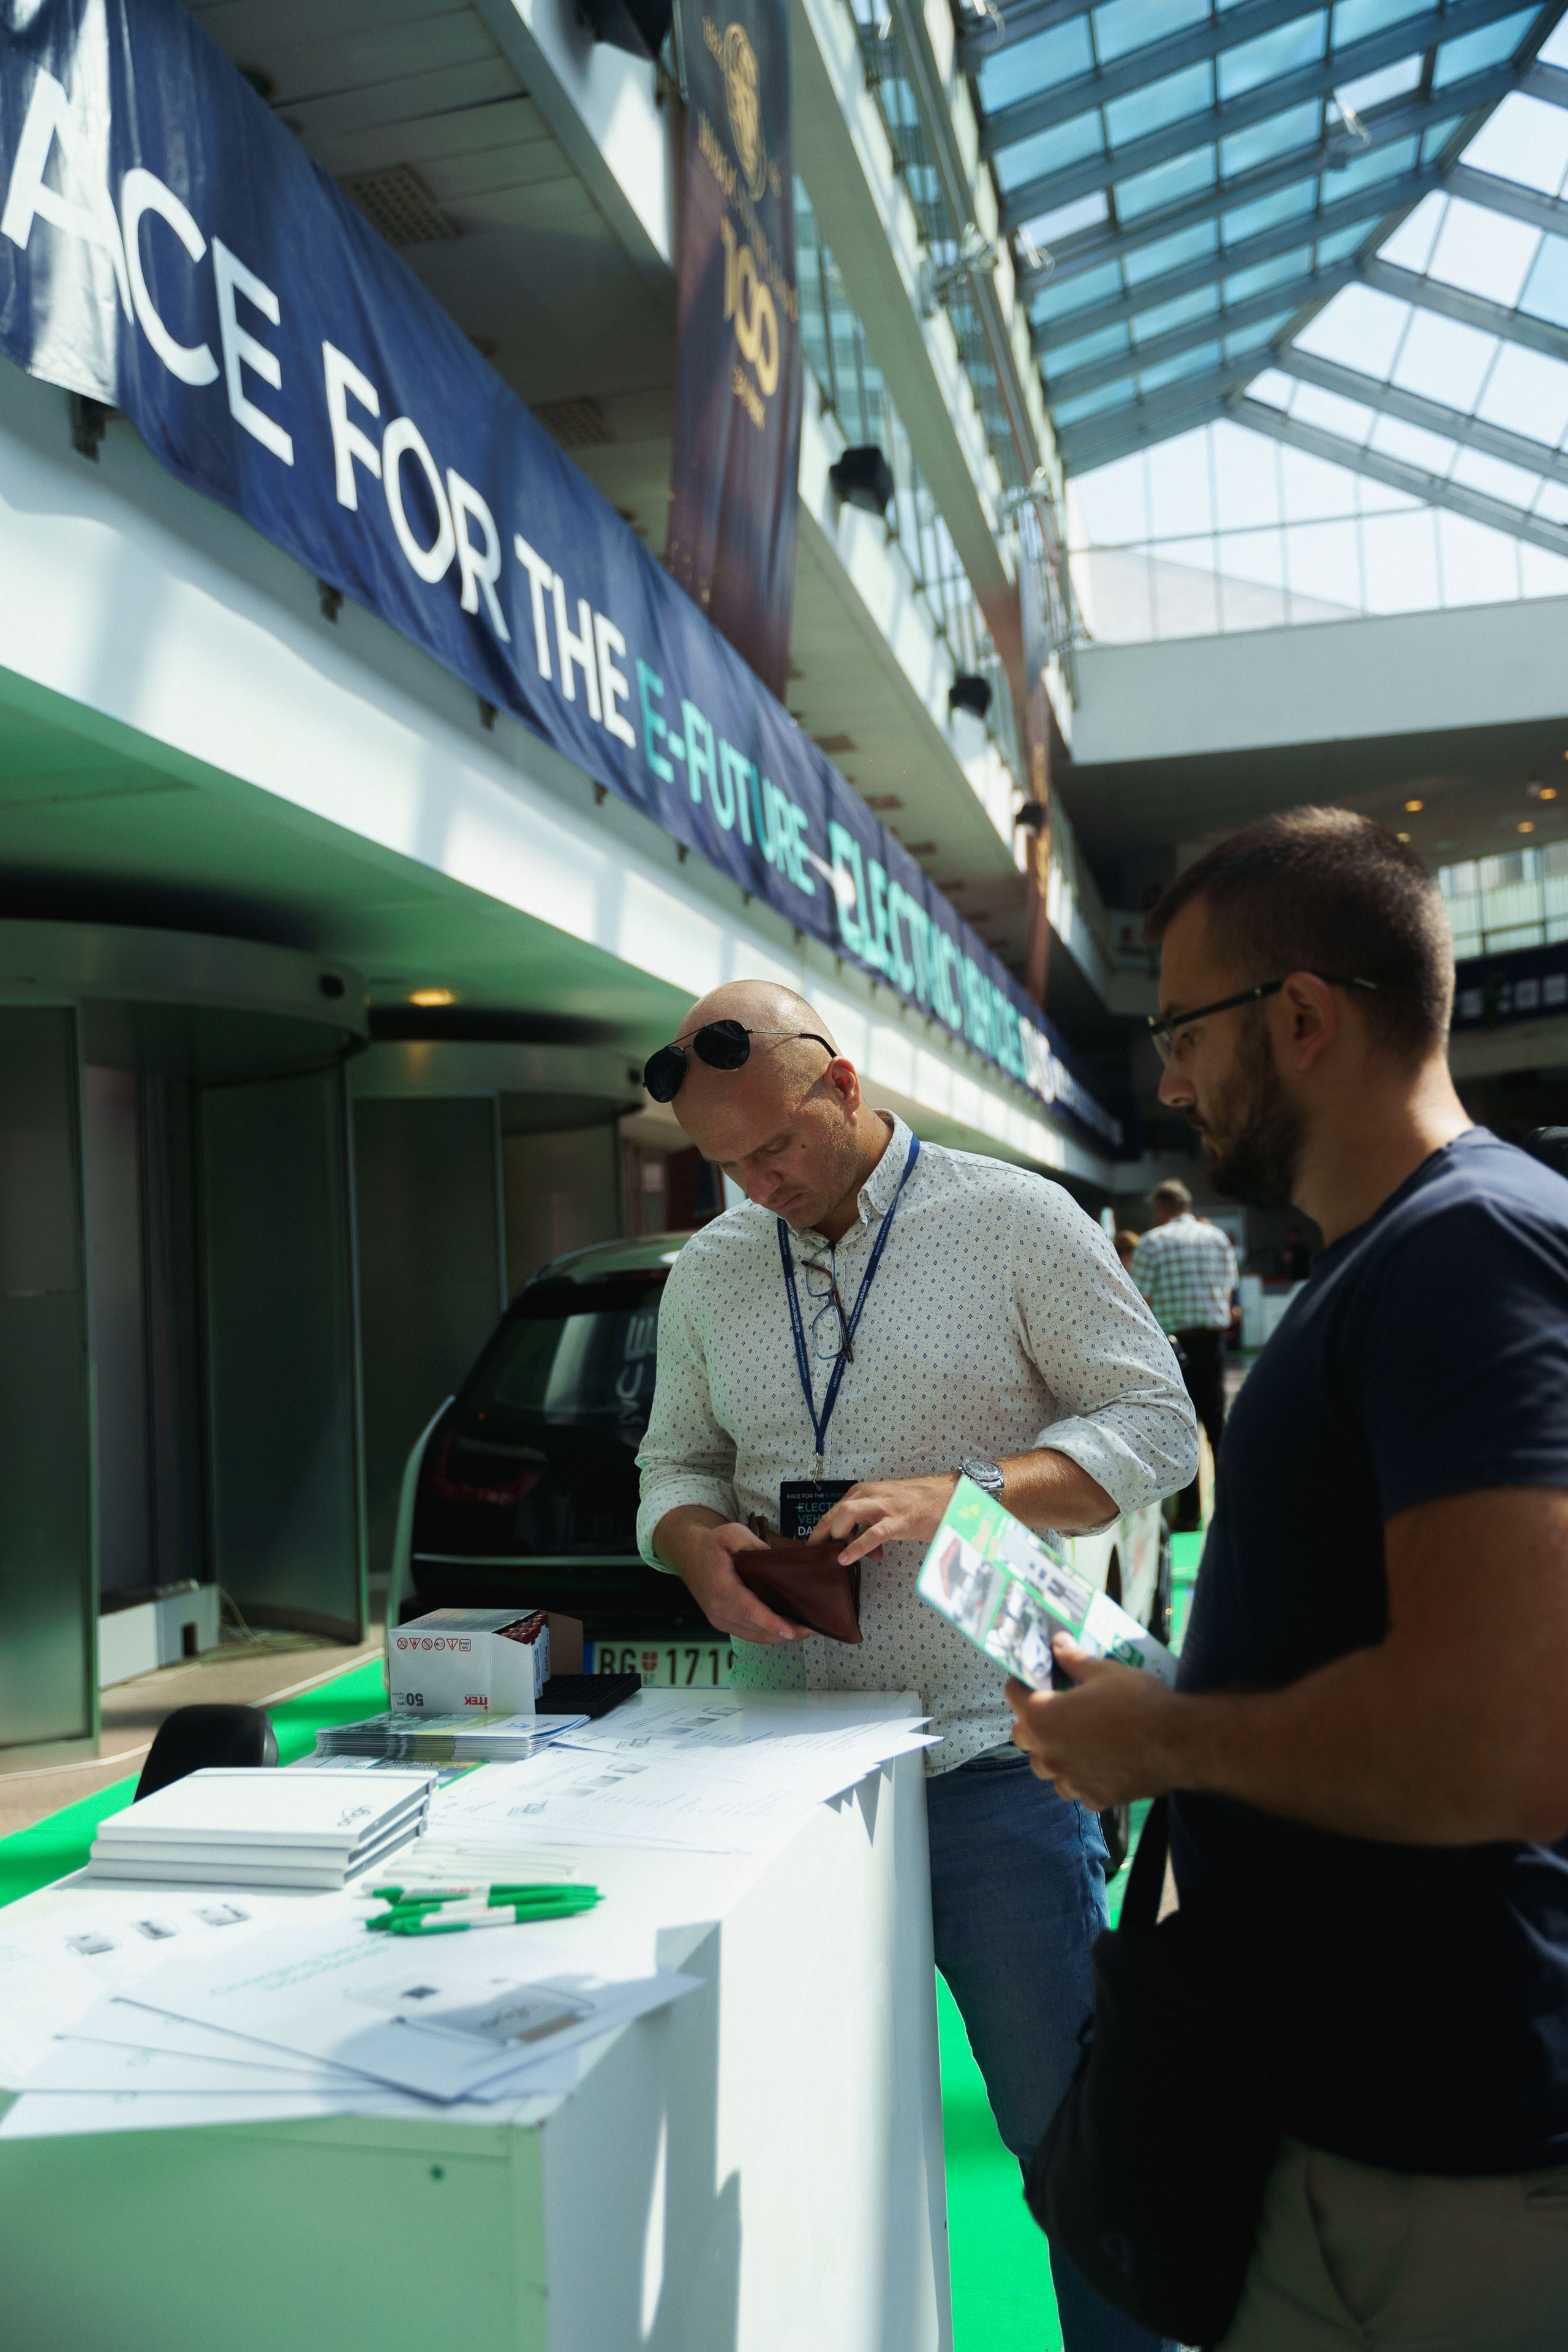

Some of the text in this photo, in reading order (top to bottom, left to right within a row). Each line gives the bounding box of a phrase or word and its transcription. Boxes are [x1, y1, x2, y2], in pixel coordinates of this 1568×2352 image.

[1, 67, 295, 467] ACE
[323, 339, 511, 643] FOR
[513, 532, 637, 750] THE
[635, 657, 816, 897] E-FUTURE
[849, 1316, 858, 1336] LECTRIC
[854, 1292, 865, 1316] VEHICLES
[797, 1502, 837, 1512] ELECT
[798, 1526, 816, 1536] DA
[600, 1648, 636, 1674] BG
[406, 1692, 424, 1706] 50
